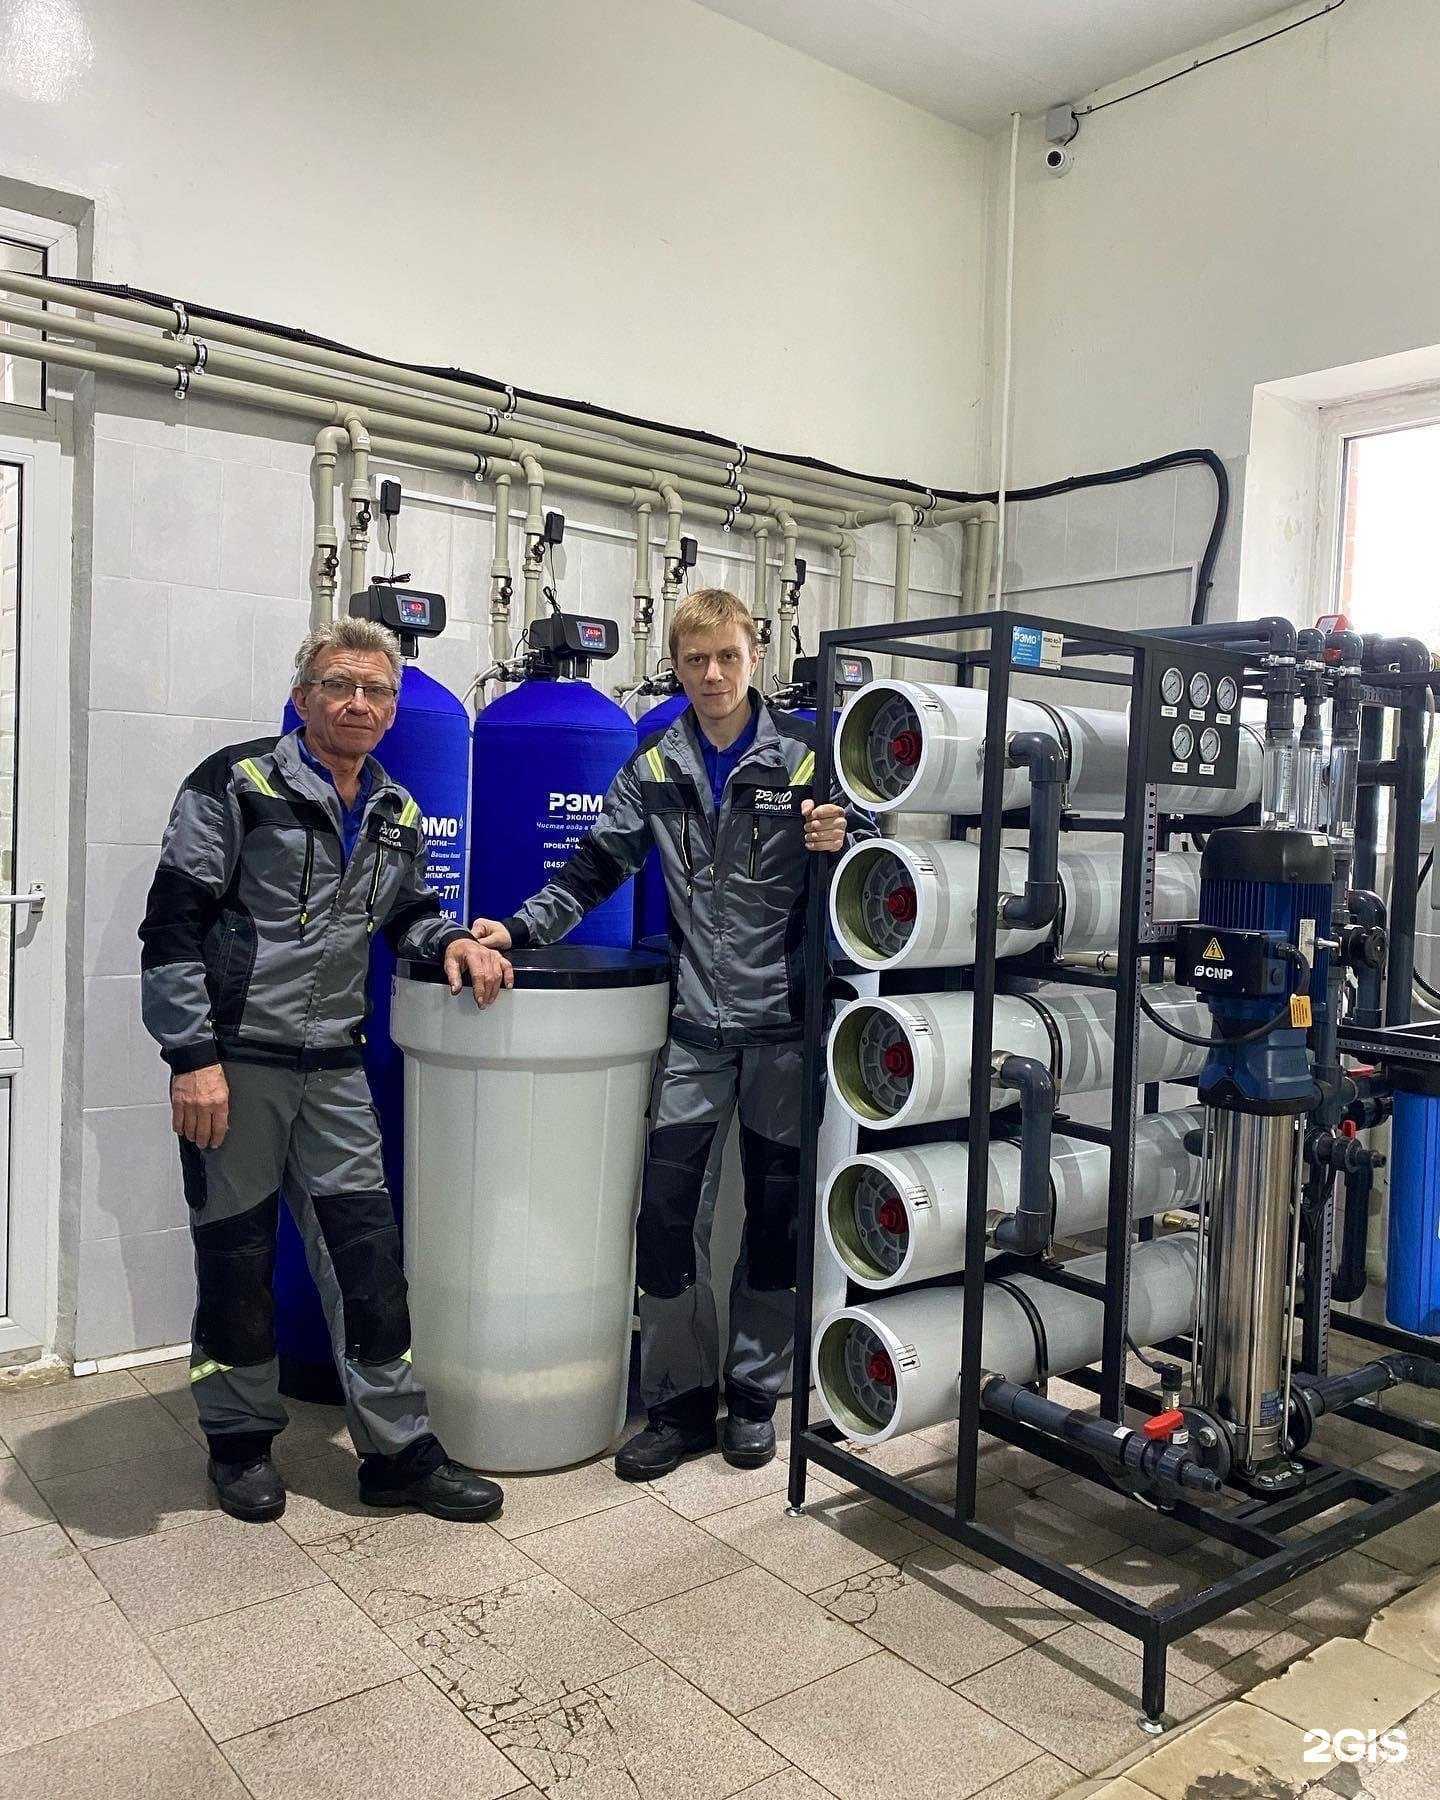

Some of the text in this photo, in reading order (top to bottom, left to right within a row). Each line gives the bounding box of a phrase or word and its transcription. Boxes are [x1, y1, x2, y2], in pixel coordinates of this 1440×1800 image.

[549, 792, 603, 812] РЭМ
[421, 816, 457, 837] ЭМО
[544, 860, 566, 869] (8452
[1205, 967, 1233, 979] CNP
